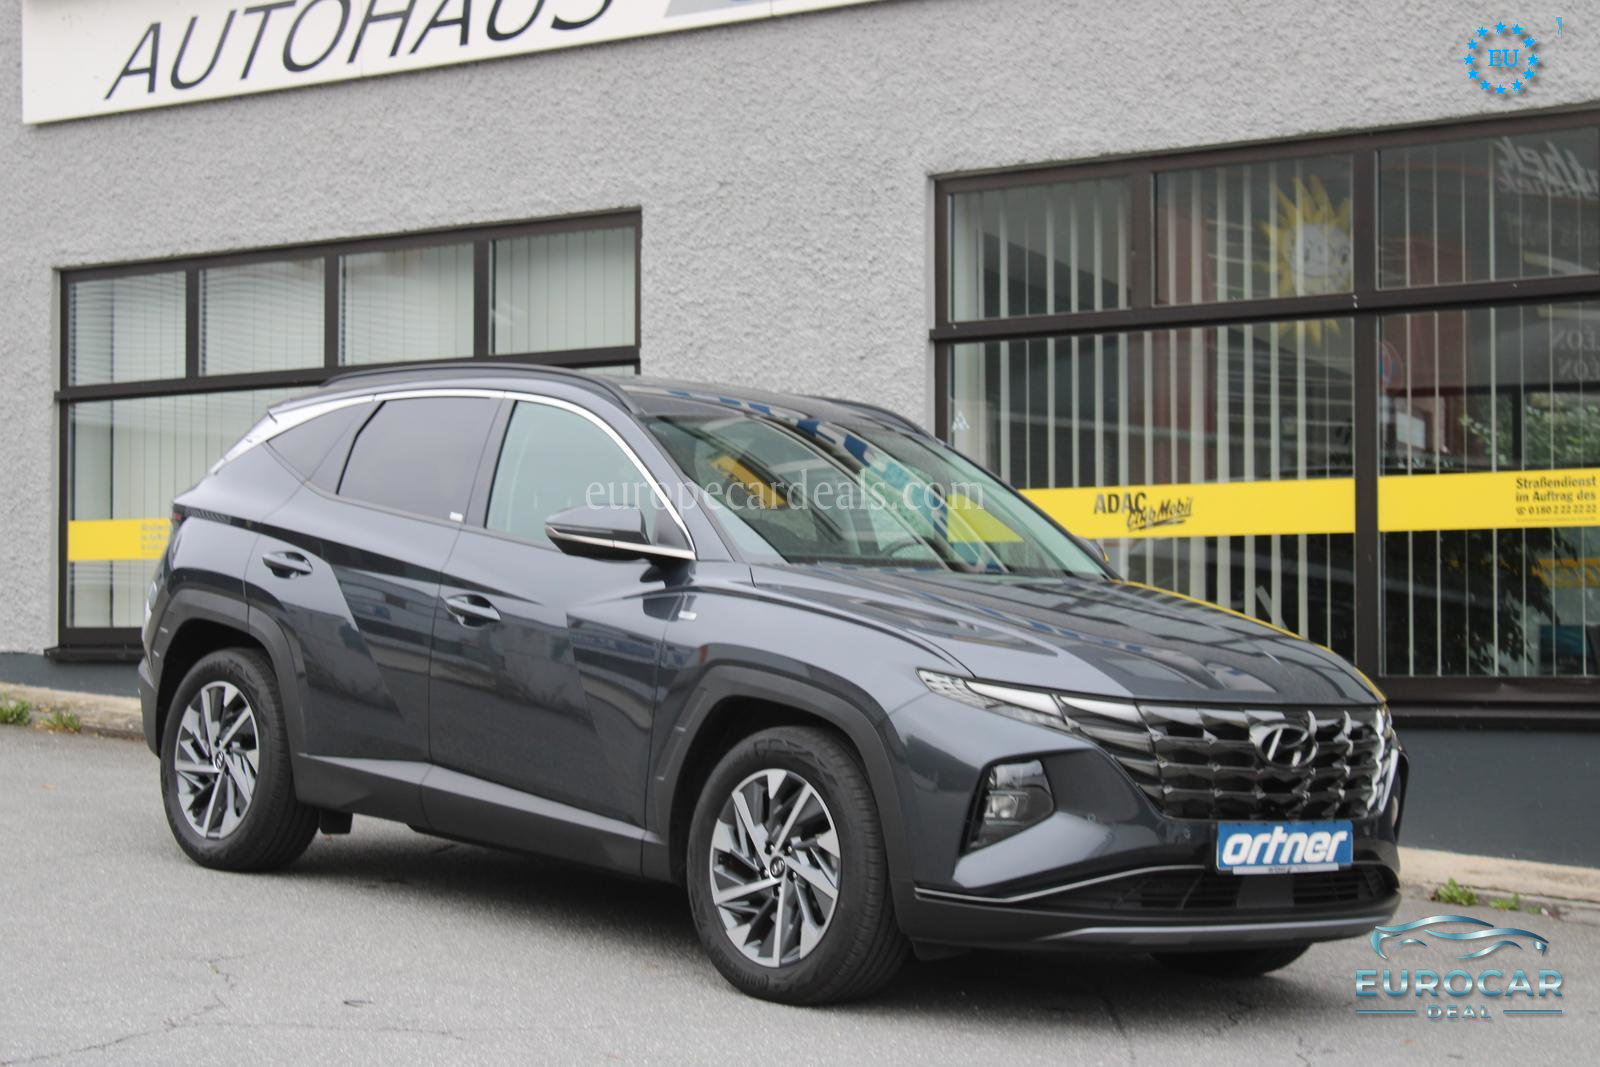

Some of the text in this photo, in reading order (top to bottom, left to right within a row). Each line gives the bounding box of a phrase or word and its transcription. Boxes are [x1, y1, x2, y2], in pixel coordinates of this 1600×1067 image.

[1516, 475, 1596, 489] Straßendienst
[1094, 492, 1147, 514] ADAC
[1515, 490, 1596, 503] im Auftrag des
[1222, 826, 1347, 864] ortner
